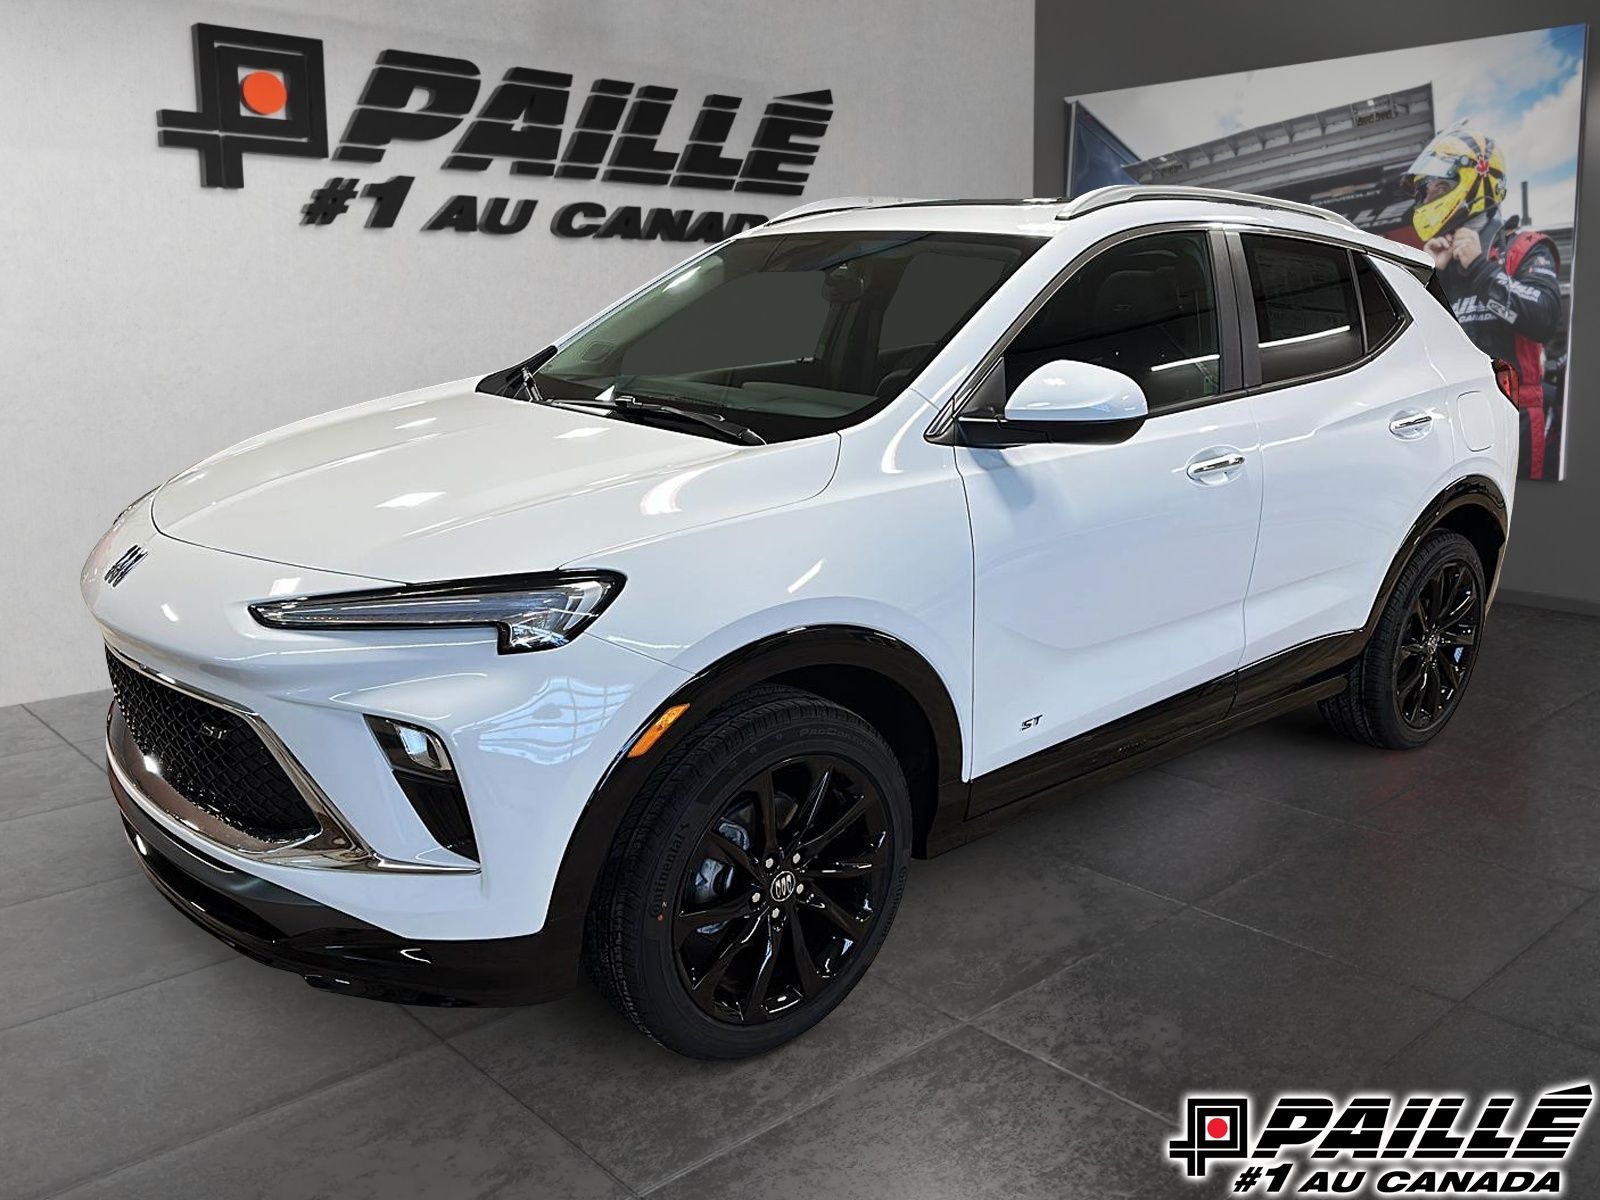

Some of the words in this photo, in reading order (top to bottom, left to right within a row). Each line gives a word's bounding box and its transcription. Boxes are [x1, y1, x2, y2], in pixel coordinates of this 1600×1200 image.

[331, 48, 834, 196] PAILLÉ
[299, 174, 416, 230] #1
[420, 193, 539, 236] AU
[550, 201, 769, 243] CANAD
[1020, 713, 1043, 731] ST
